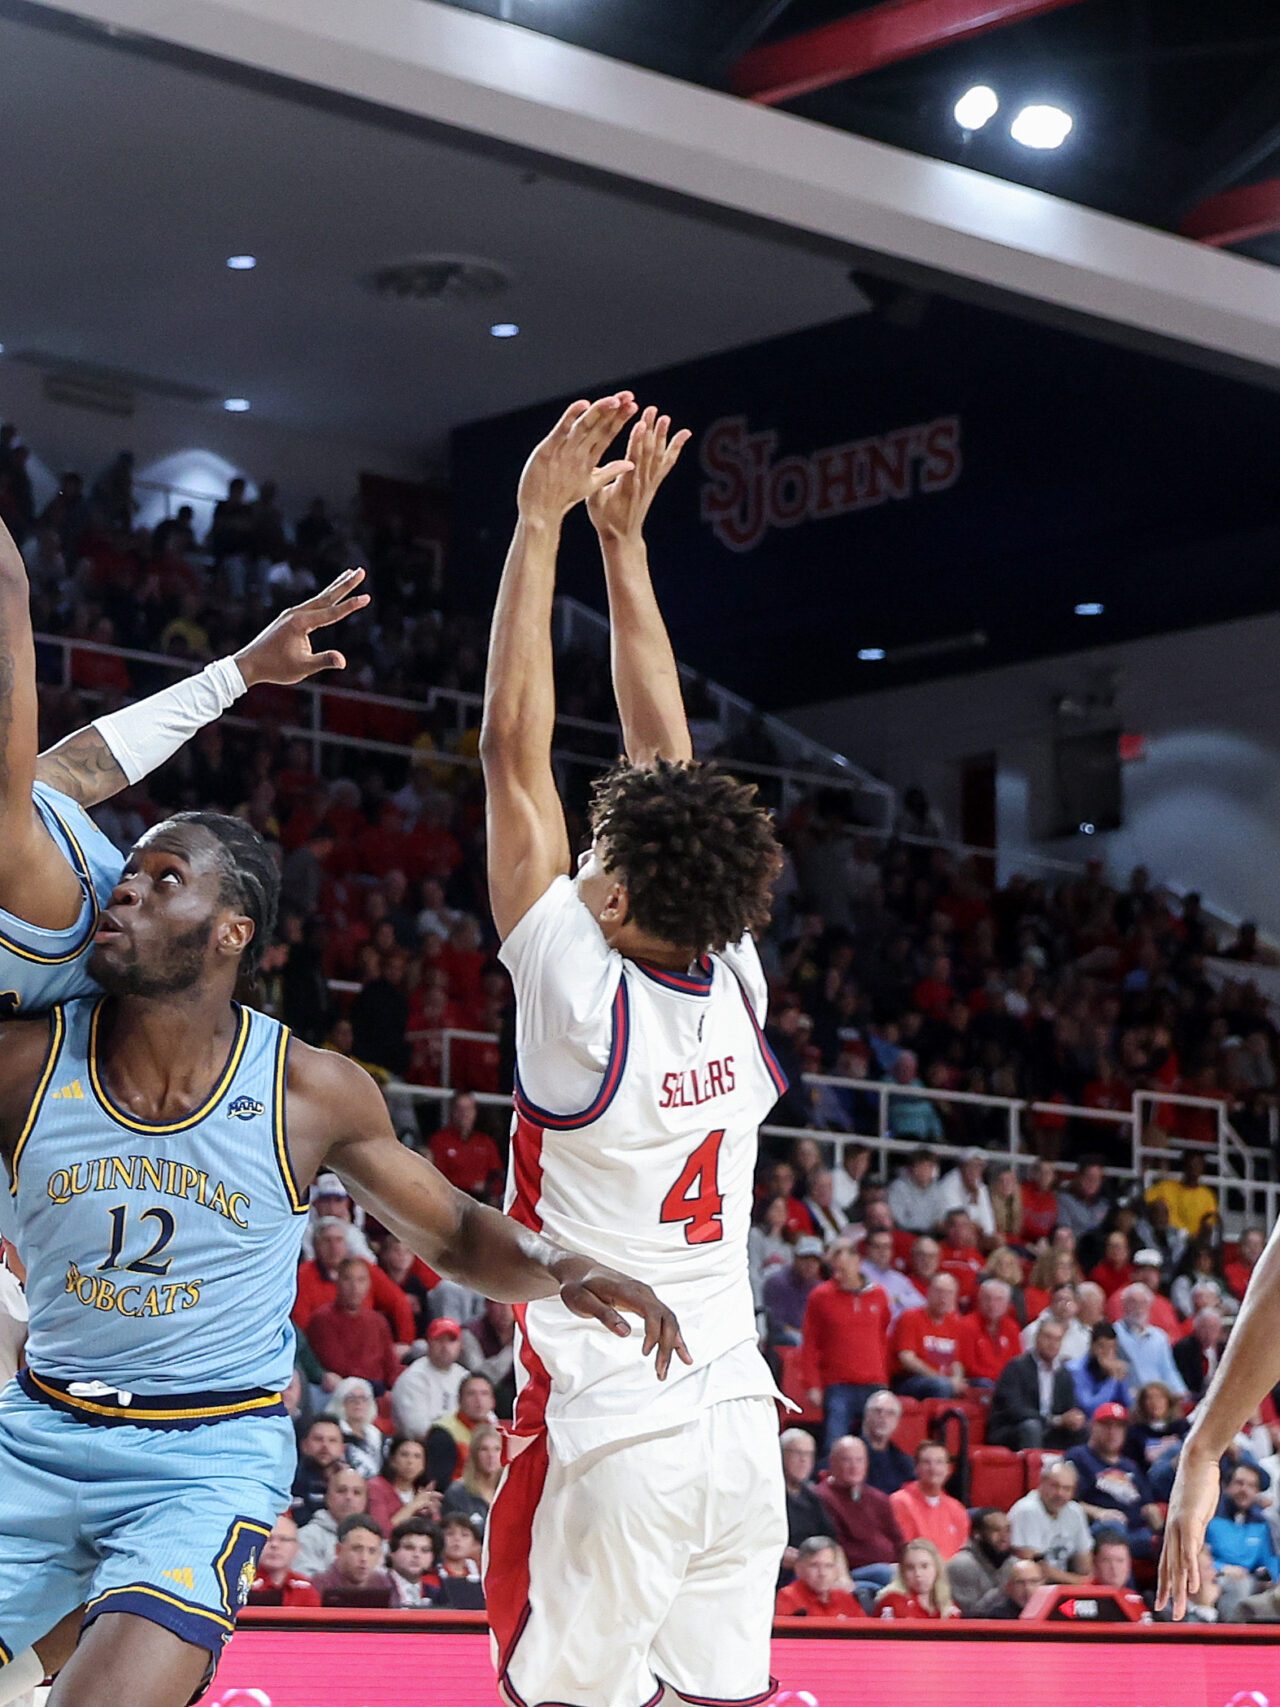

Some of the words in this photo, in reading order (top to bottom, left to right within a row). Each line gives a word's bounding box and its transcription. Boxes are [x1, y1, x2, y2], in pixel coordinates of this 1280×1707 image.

[659, 1055, 735, 1108] SELLERS
[47, 1155, 251, 1229] QUINNIPIAC
[659, 1128, 726, 1245] 4
[95, 1203, 177, 1276] 12
